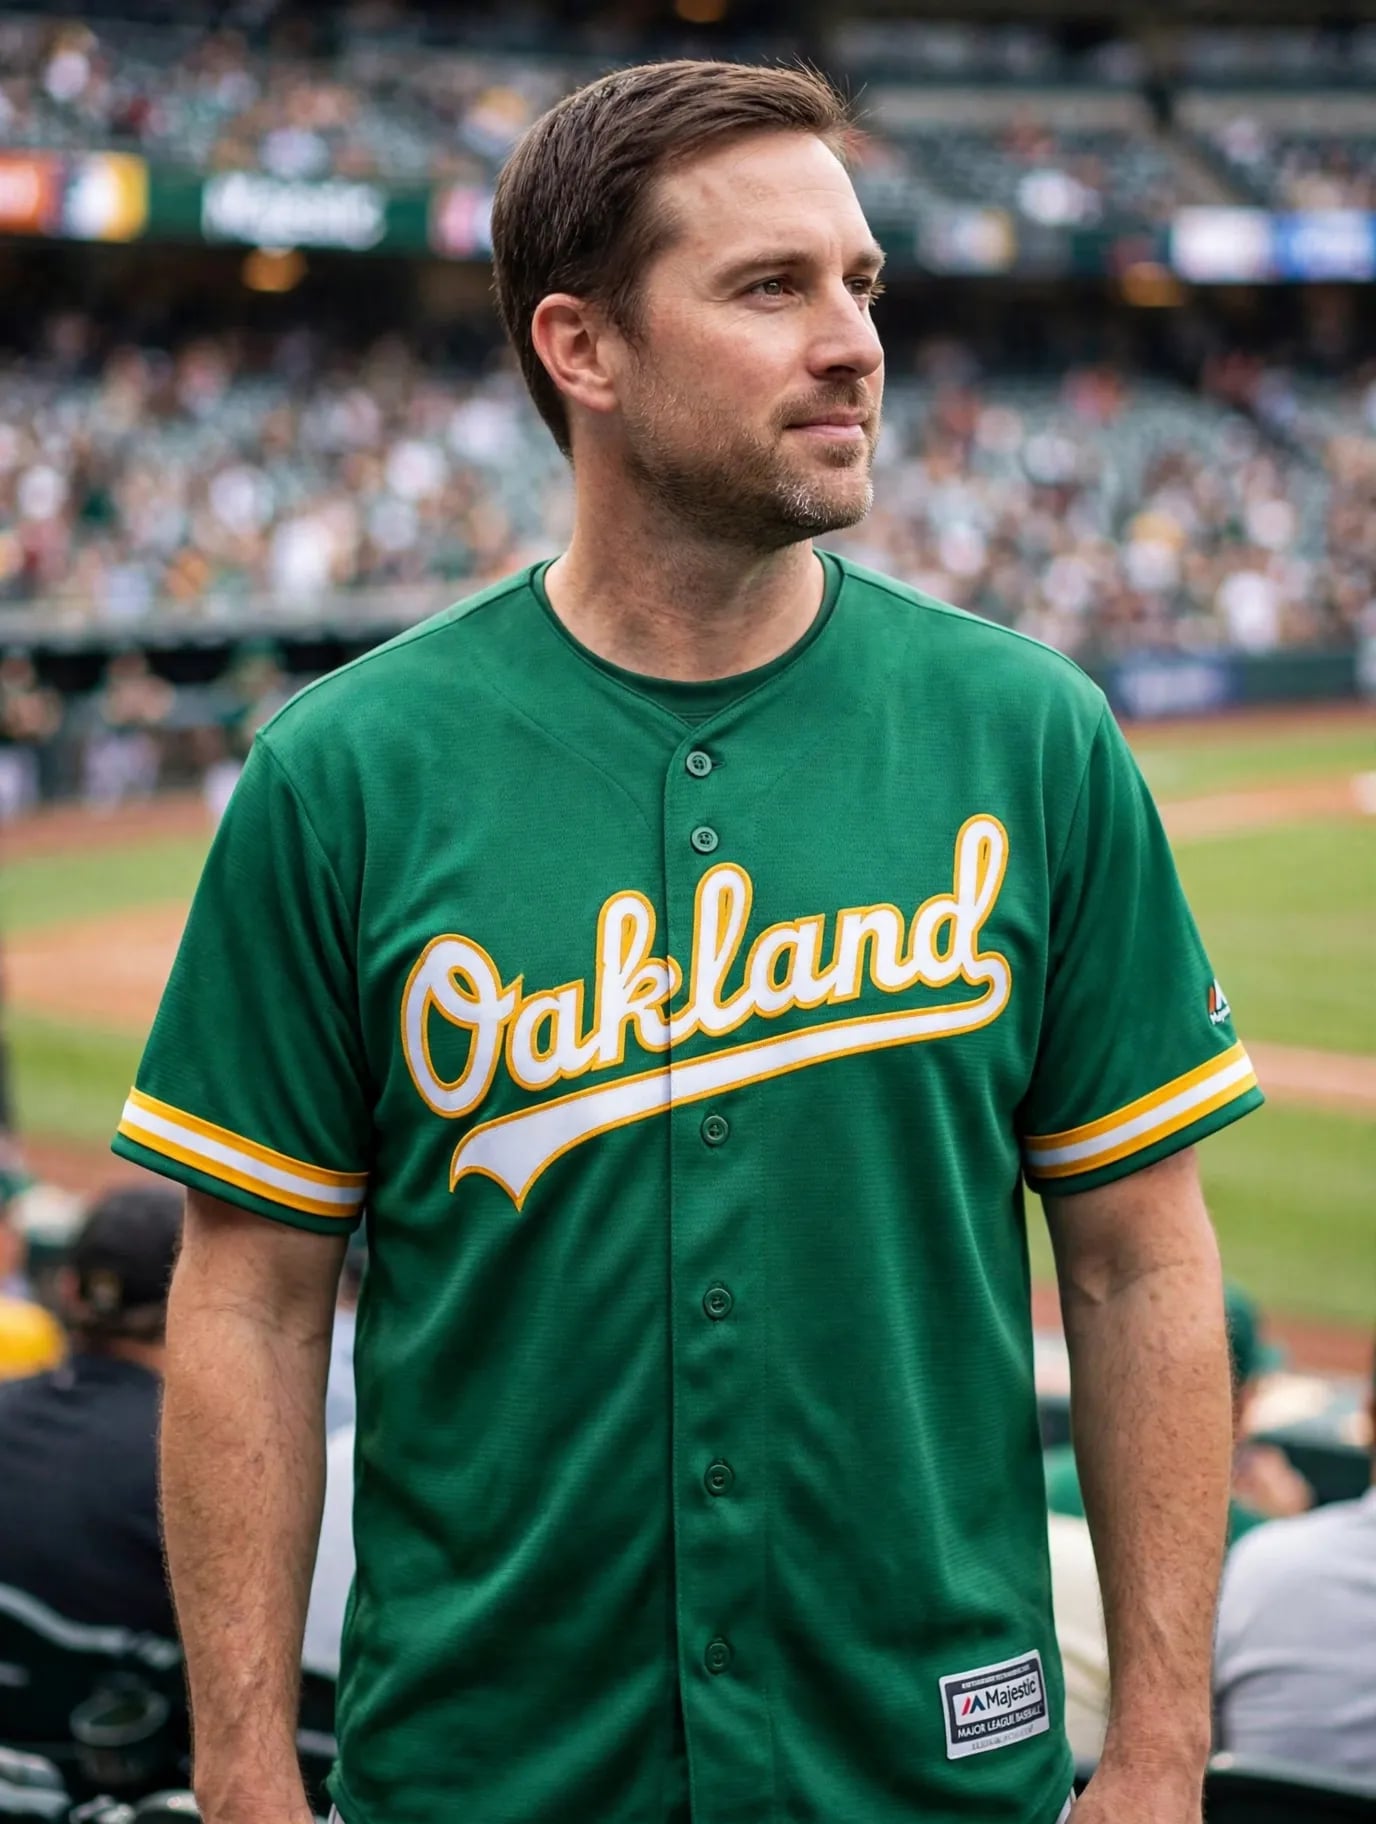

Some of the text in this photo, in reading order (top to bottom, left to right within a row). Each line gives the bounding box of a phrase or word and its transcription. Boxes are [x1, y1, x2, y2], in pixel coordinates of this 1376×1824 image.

[401, 813, 1011, 1118] Oakland
[985, 1678, 1037, 1708] Majestic
[957, 1723, 986, 1738] MAJOR
